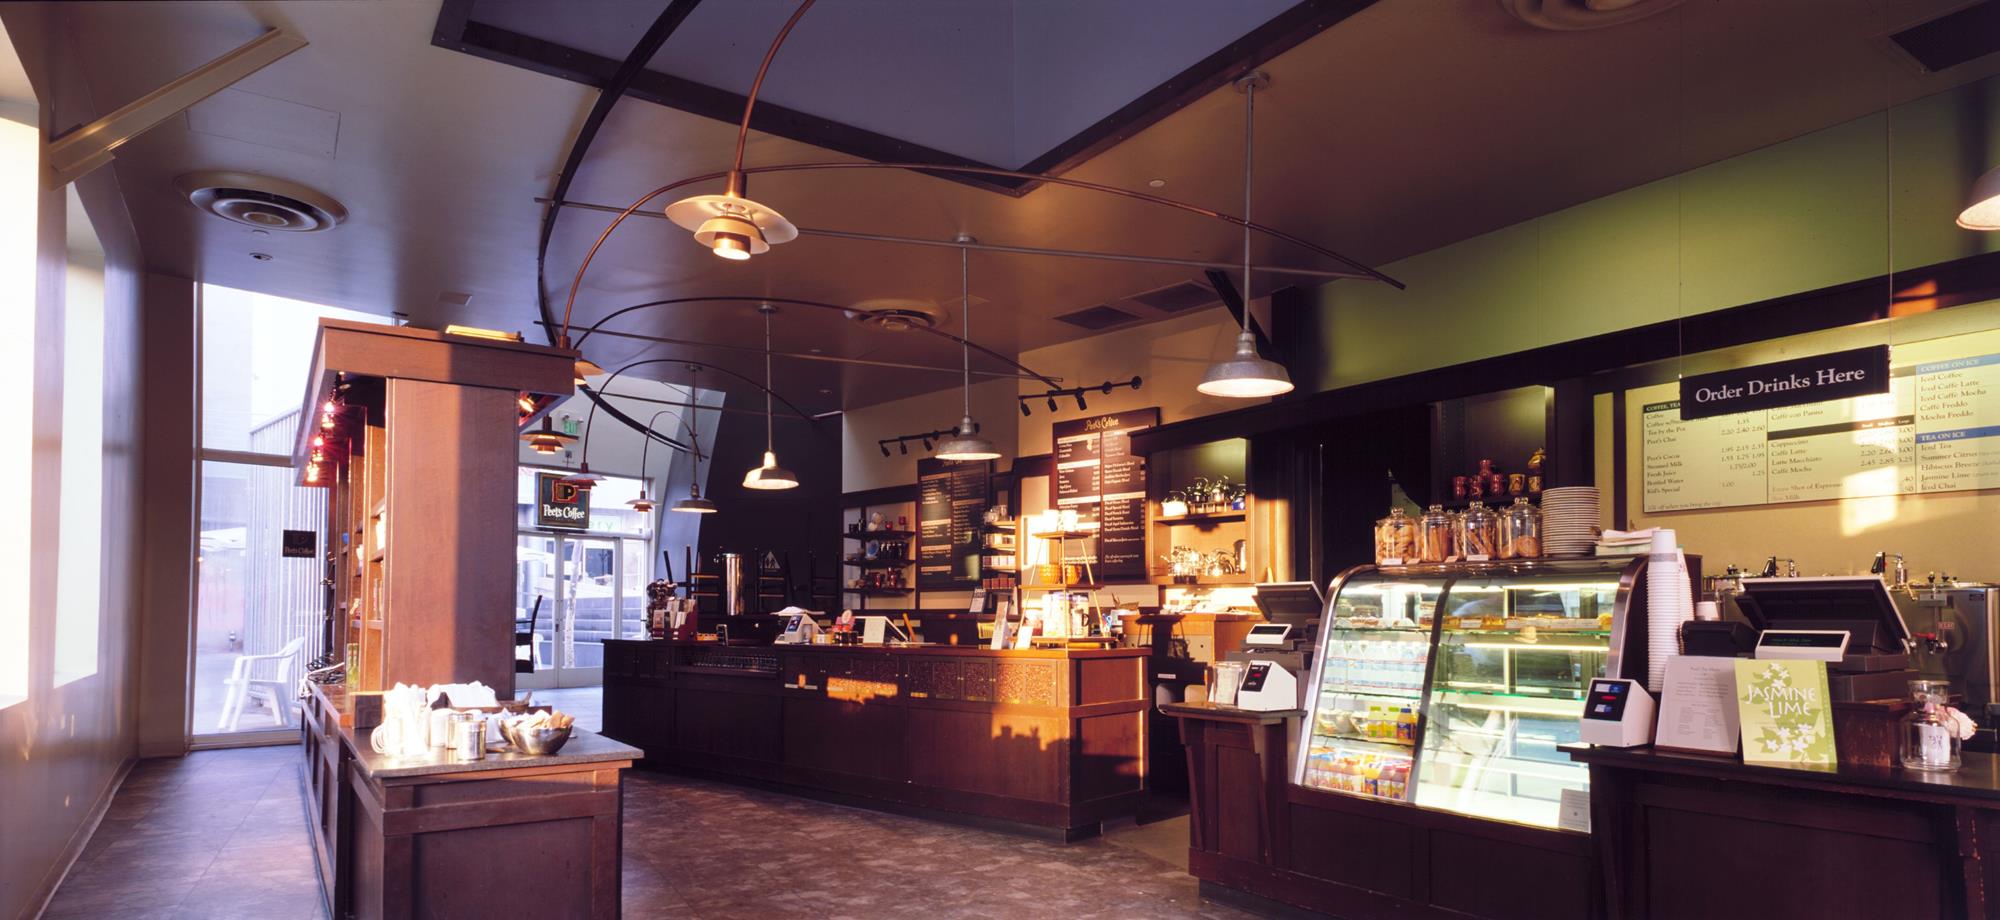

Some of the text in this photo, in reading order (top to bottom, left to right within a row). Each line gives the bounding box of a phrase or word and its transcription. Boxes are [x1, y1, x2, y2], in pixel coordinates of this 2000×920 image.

[1695, 368, 1865, 403] Order Drinks Here
[1961, 389, 1986, 397] Mocha
[1942, 401, 1968, 409] Freddo
[1920, 410, 1974, 421] Mocha Freddo
[1921, 463, 1953, 471] Hibiscus
[1921, 473, 1950, 482] Jasmine
[563, 506, 585, 520] Coffee
[1744, 684, 1817, 705] JASMINE
[1769, 701, 1811, 718] LIME
